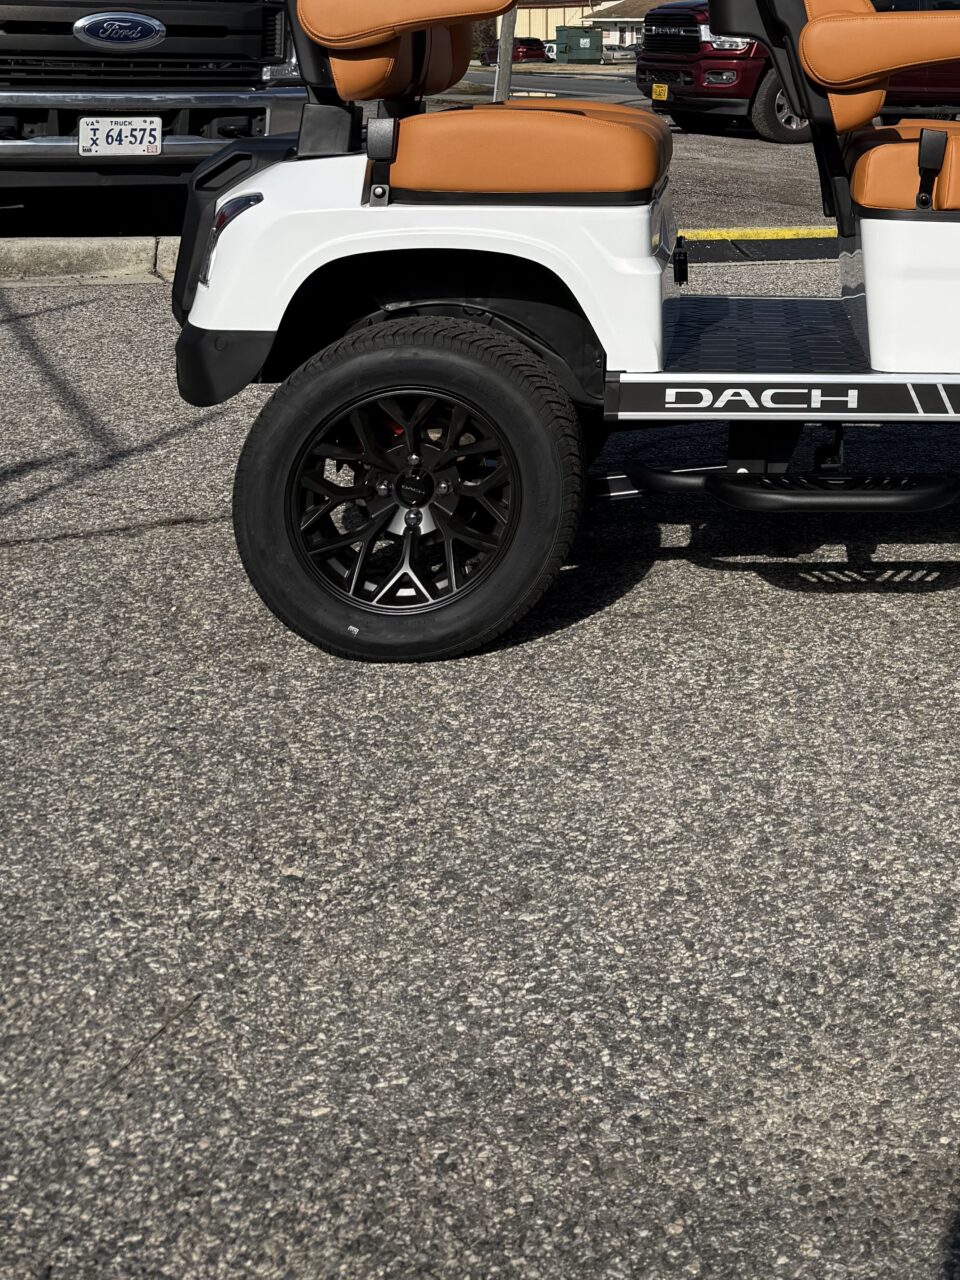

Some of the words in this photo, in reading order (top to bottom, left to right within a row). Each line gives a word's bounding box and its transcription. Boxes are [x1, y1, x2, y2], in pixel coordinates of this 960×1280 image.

[99, 21, 142, 39] Ford
[105, 128, 157, 145] 64-575
[666, 388, 859, 409] DACH
